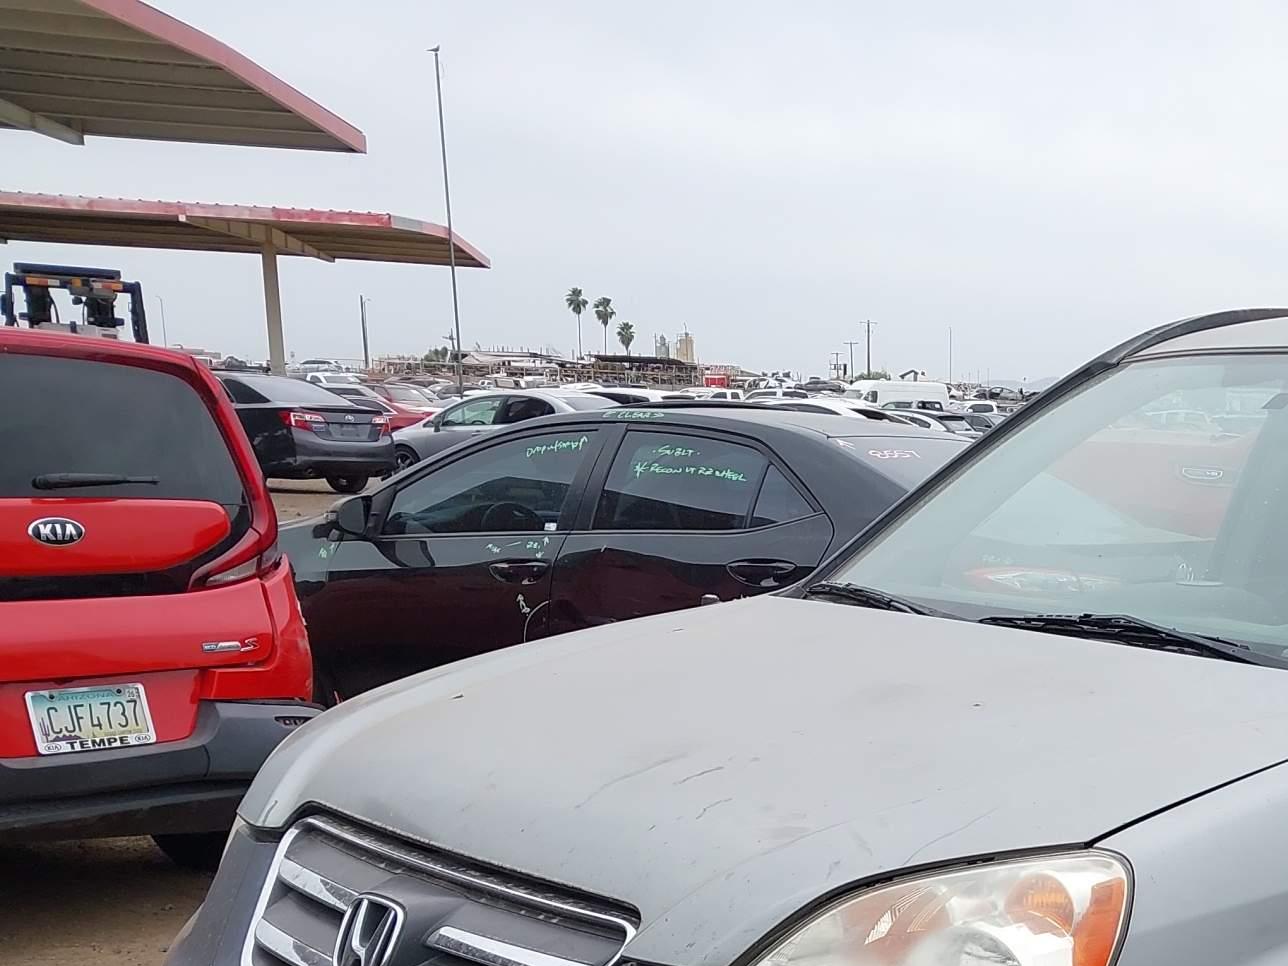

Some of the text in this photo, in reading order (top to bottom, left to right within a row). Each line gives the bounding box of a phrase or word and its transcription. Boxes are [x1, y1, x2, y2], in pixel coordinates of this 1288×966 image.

[36, 521, 79, 541] KIA
[46, 699, 140, 735] CJF4737
[67, 735, 131, 751] TEMPE
